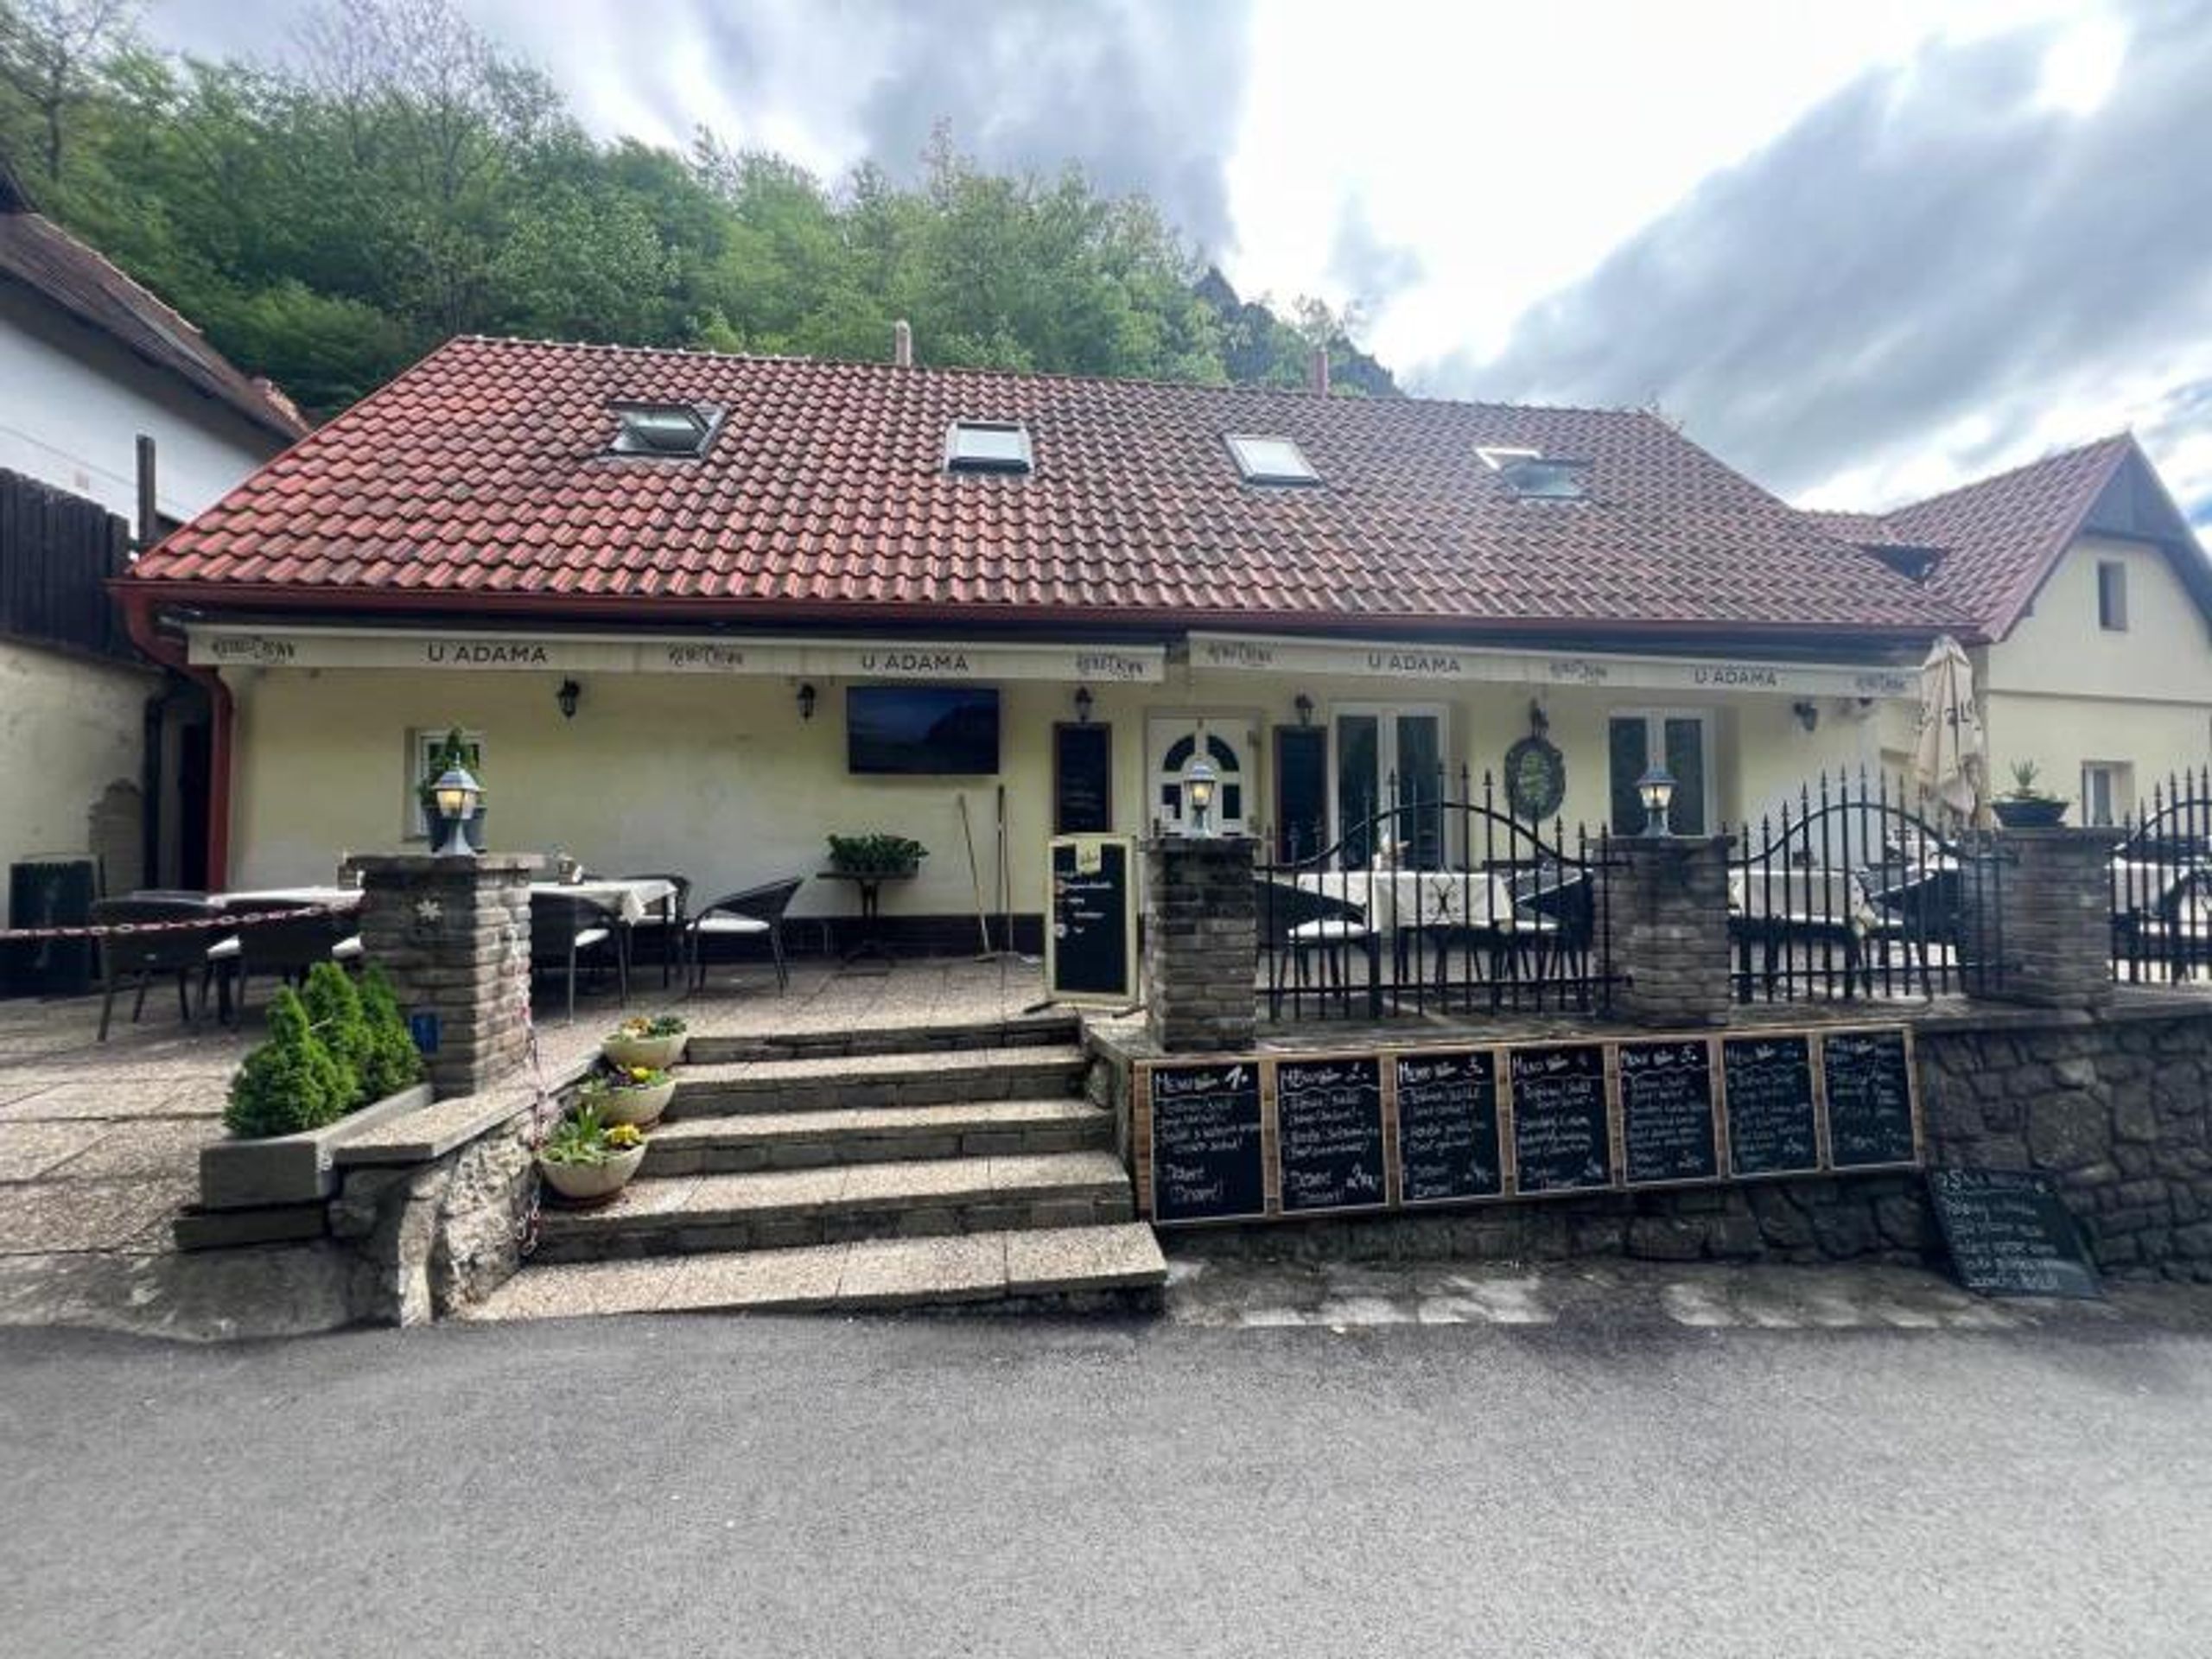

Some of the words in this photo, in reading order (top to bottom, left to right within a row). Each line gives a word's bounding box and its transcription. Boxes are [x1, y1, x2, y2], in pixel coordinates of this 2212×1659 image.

[428, 644, 445, 663] U
[457, 645, 548, 664] ADAMA
[861, 655, 874, 670] U
[884, 654, 969, 672] ADAMA
[1368, 654, 1383, 671] U
[1389, 656, 1461, 674] ADAMA
[1694, 670, 1710, 684] U
[1713, 670, 1777, 688] ADAMA
